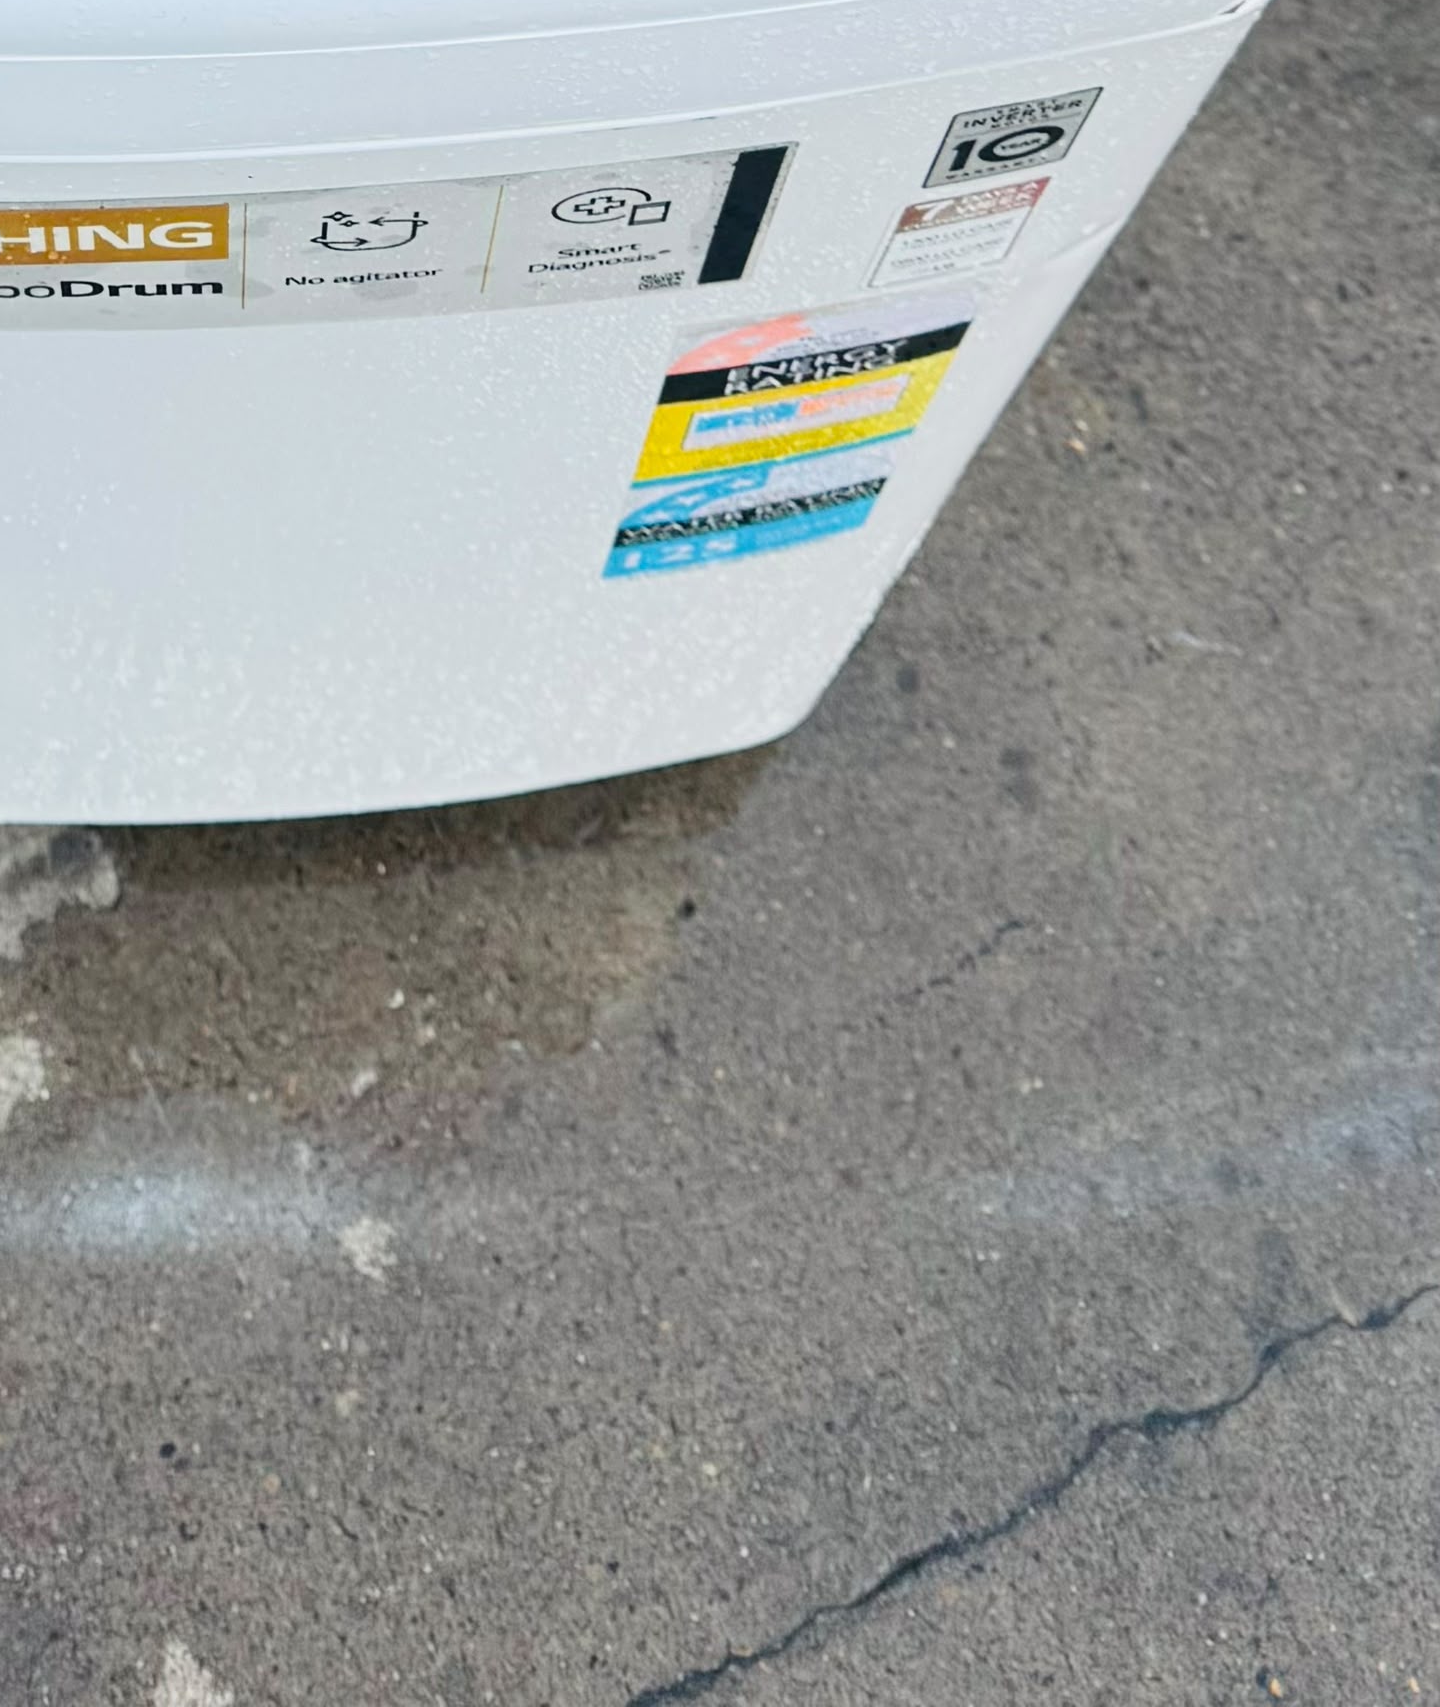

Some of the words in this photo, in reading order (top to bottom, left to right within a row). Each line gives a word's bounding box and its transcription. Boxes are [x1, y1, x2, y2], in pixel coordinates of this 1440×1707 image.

[963, 99, 1083, 129] INVERTER
[558, 243, 641, 259] Smart
[285, 274, 325, 286] No
[333, 267, 443, 285] agitator
